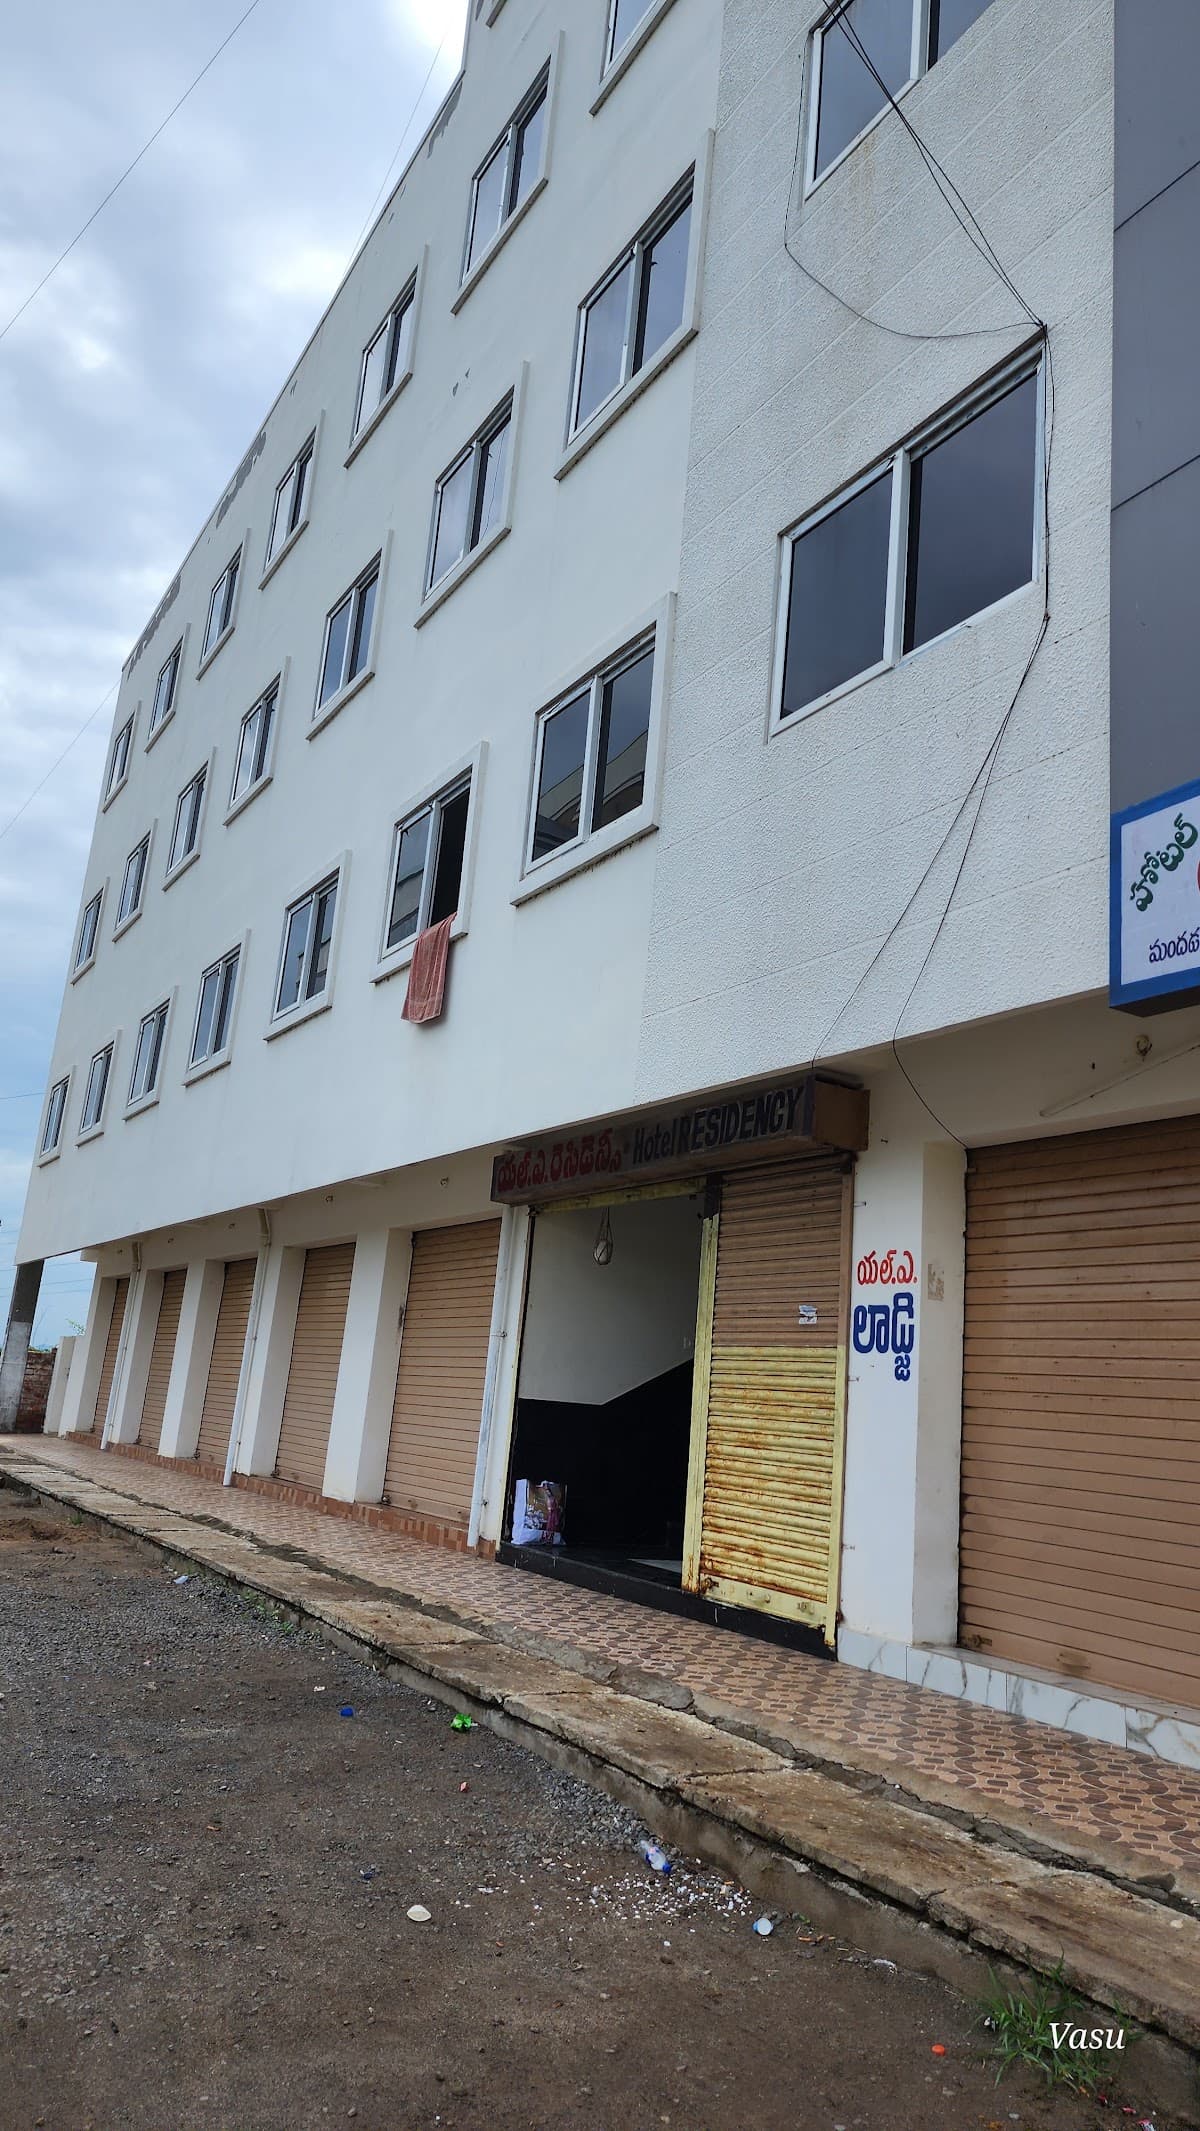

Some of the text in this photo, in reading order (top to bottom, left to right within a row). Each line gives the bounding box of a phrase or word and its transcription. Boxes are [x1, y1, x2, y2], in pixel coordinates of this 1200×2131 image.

[633, 1086, 805, 1166] Hotel RESIDENCY
[853, 1291, 915, 1382] లాడ్జి
